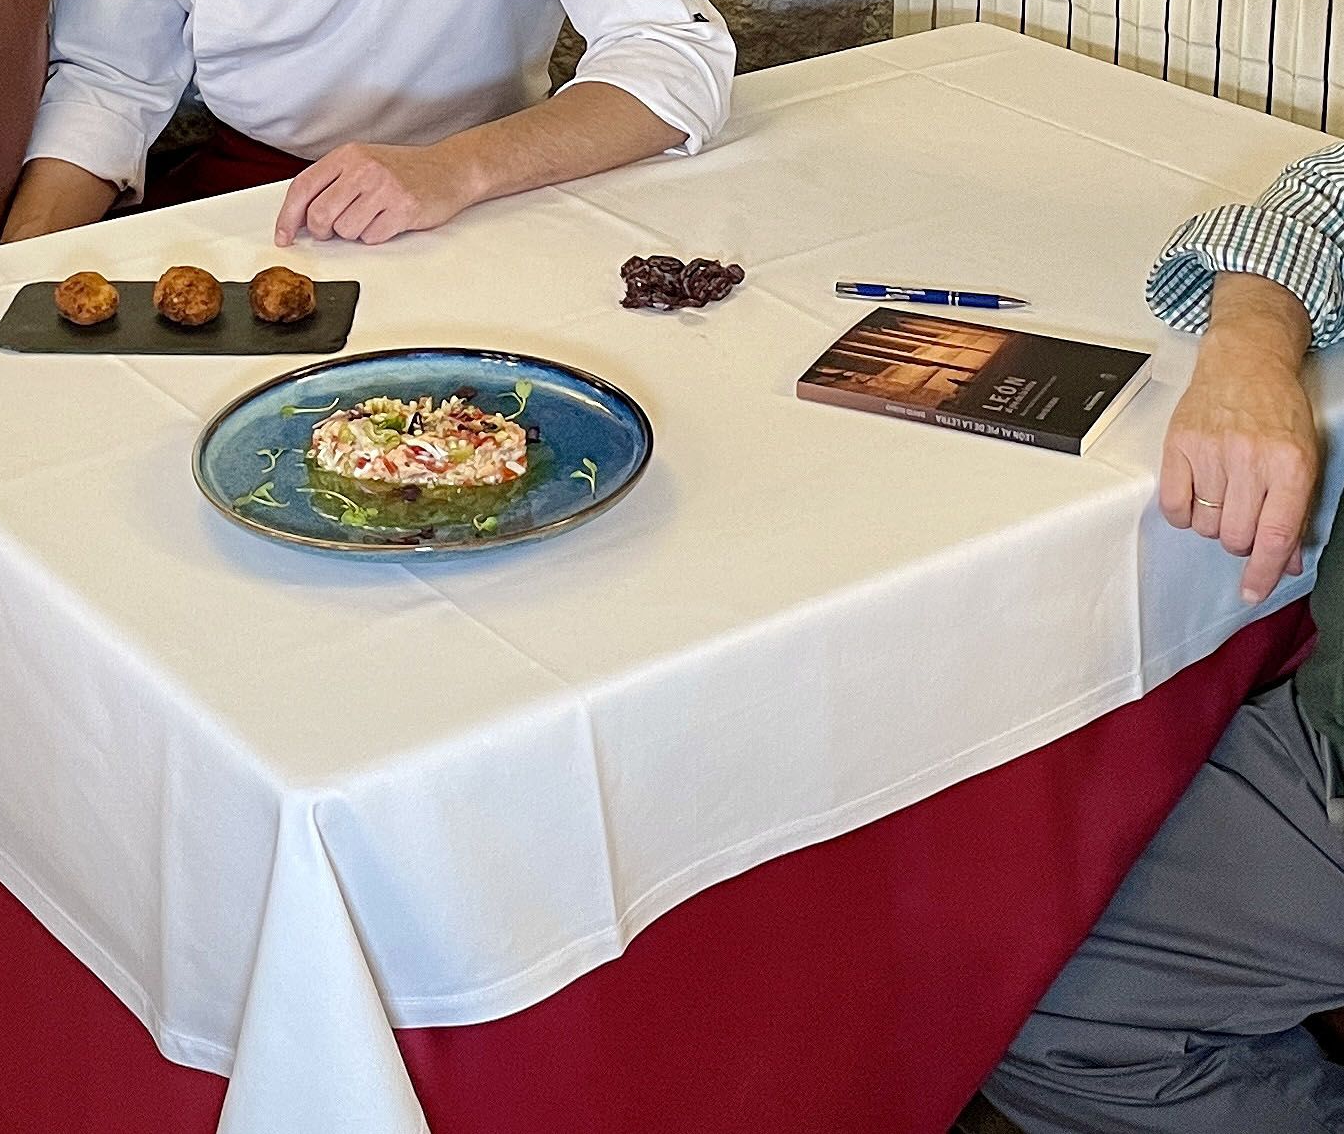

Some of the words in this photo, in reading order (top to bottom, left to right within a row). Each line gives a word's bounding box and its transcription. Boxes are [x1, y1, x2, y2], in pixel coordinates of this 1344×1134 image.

[979, 376, 1026, 412] LEÓN
[935, 414, 961, 427] LETRA
[962, 419, 973, 430] LA
[975, 422, 985, 433] DE
[987, 424, 1000, 435] PIE
[1001, 427, 1012, 438] AL
[1012, 430, 1035, 443] LEÓN
